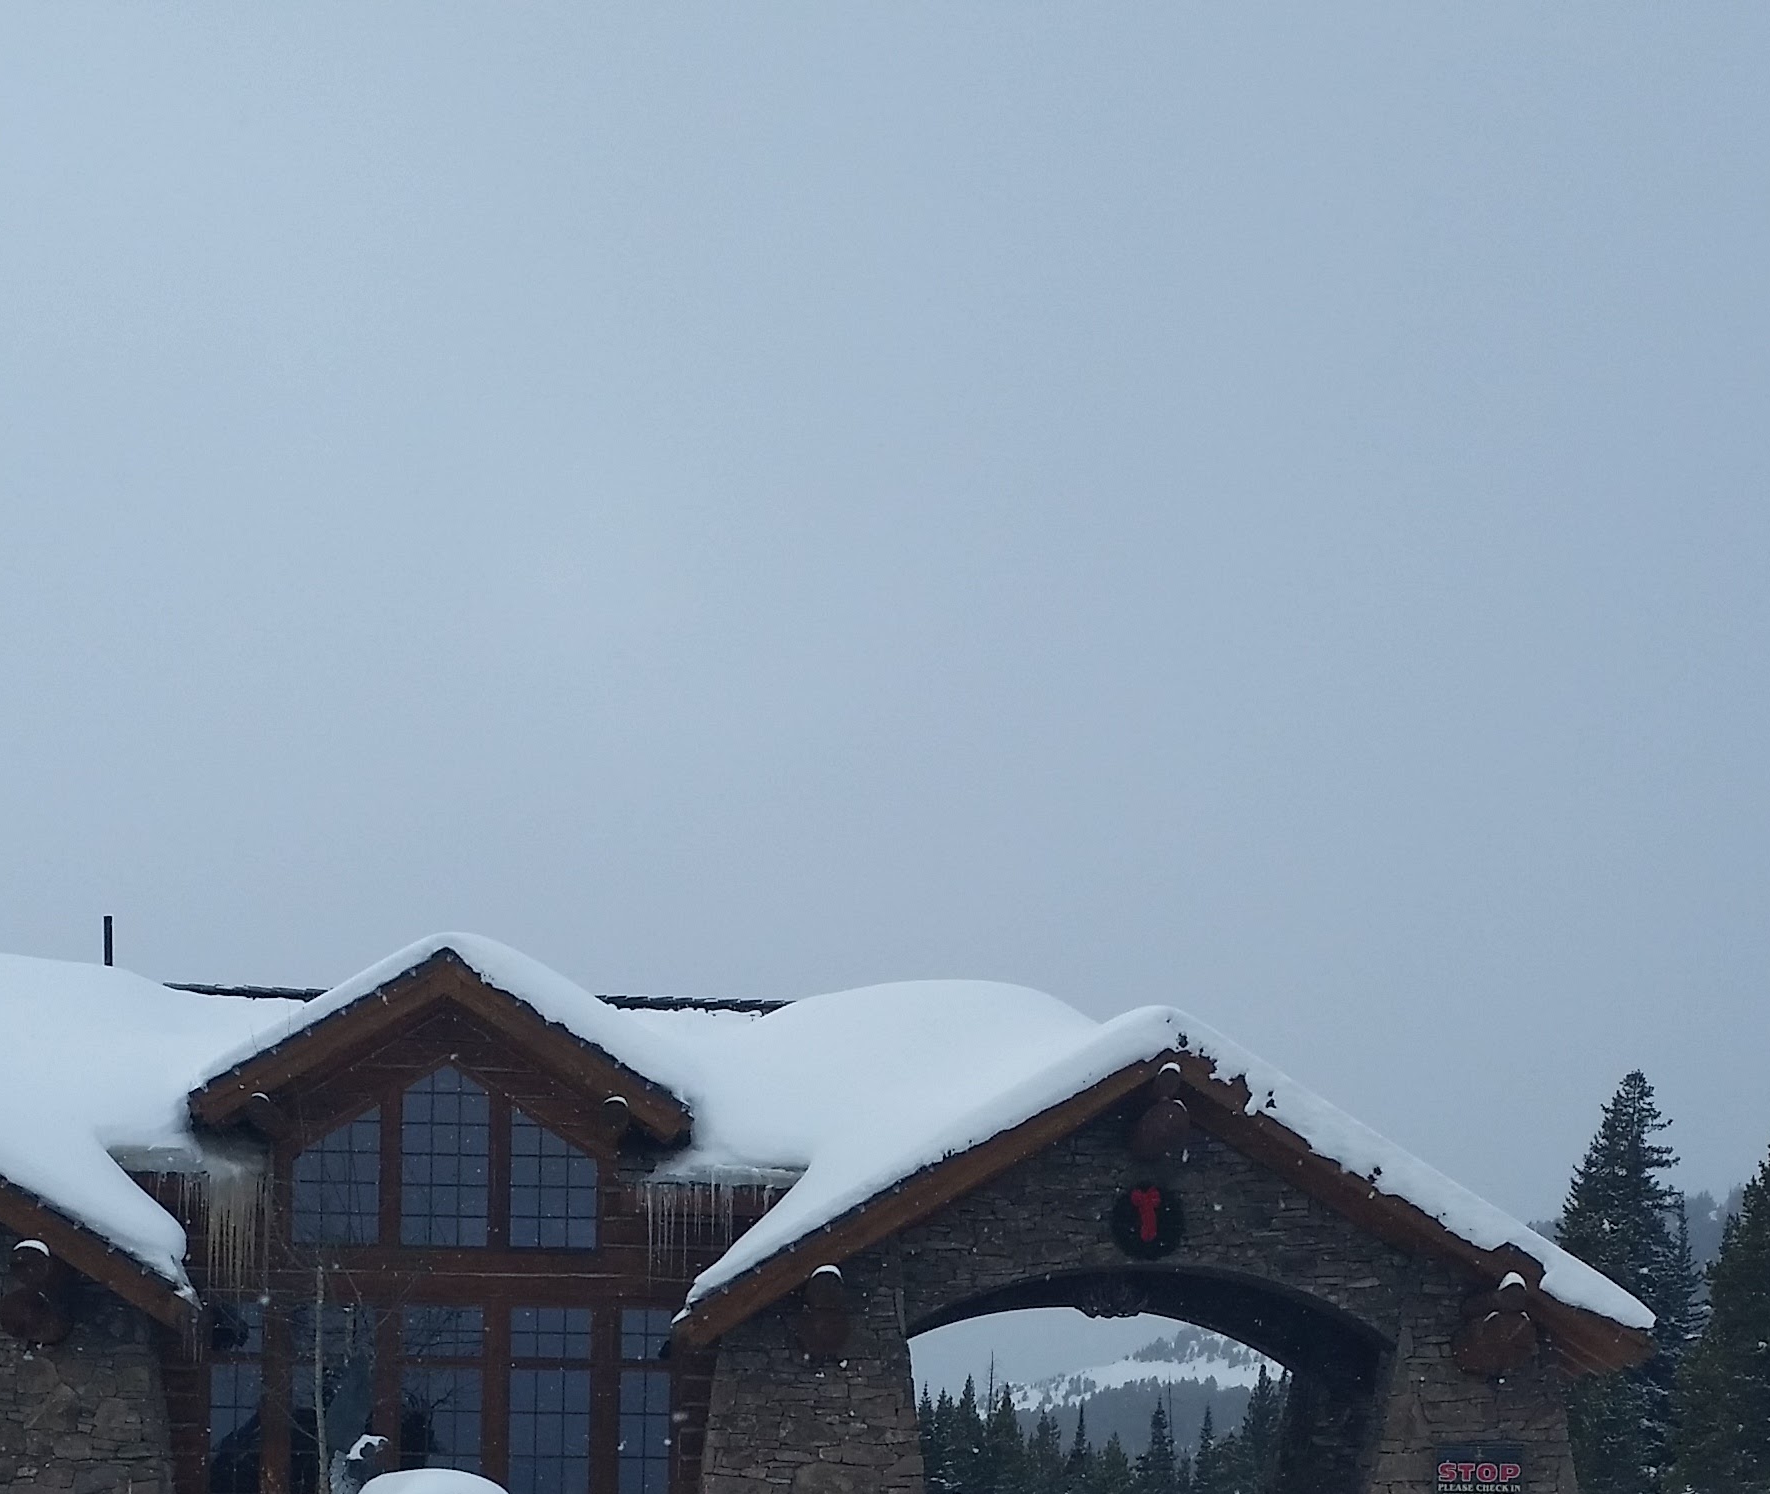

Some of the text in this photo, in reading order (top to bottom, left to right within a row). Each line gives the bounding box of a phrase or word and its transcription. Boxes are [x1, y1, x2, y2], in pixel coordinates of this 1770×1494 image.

[1438, 1462, 1521, 1482] STOP
[1438, 1484, 1521, 1492] PLEASE CHECK IN
